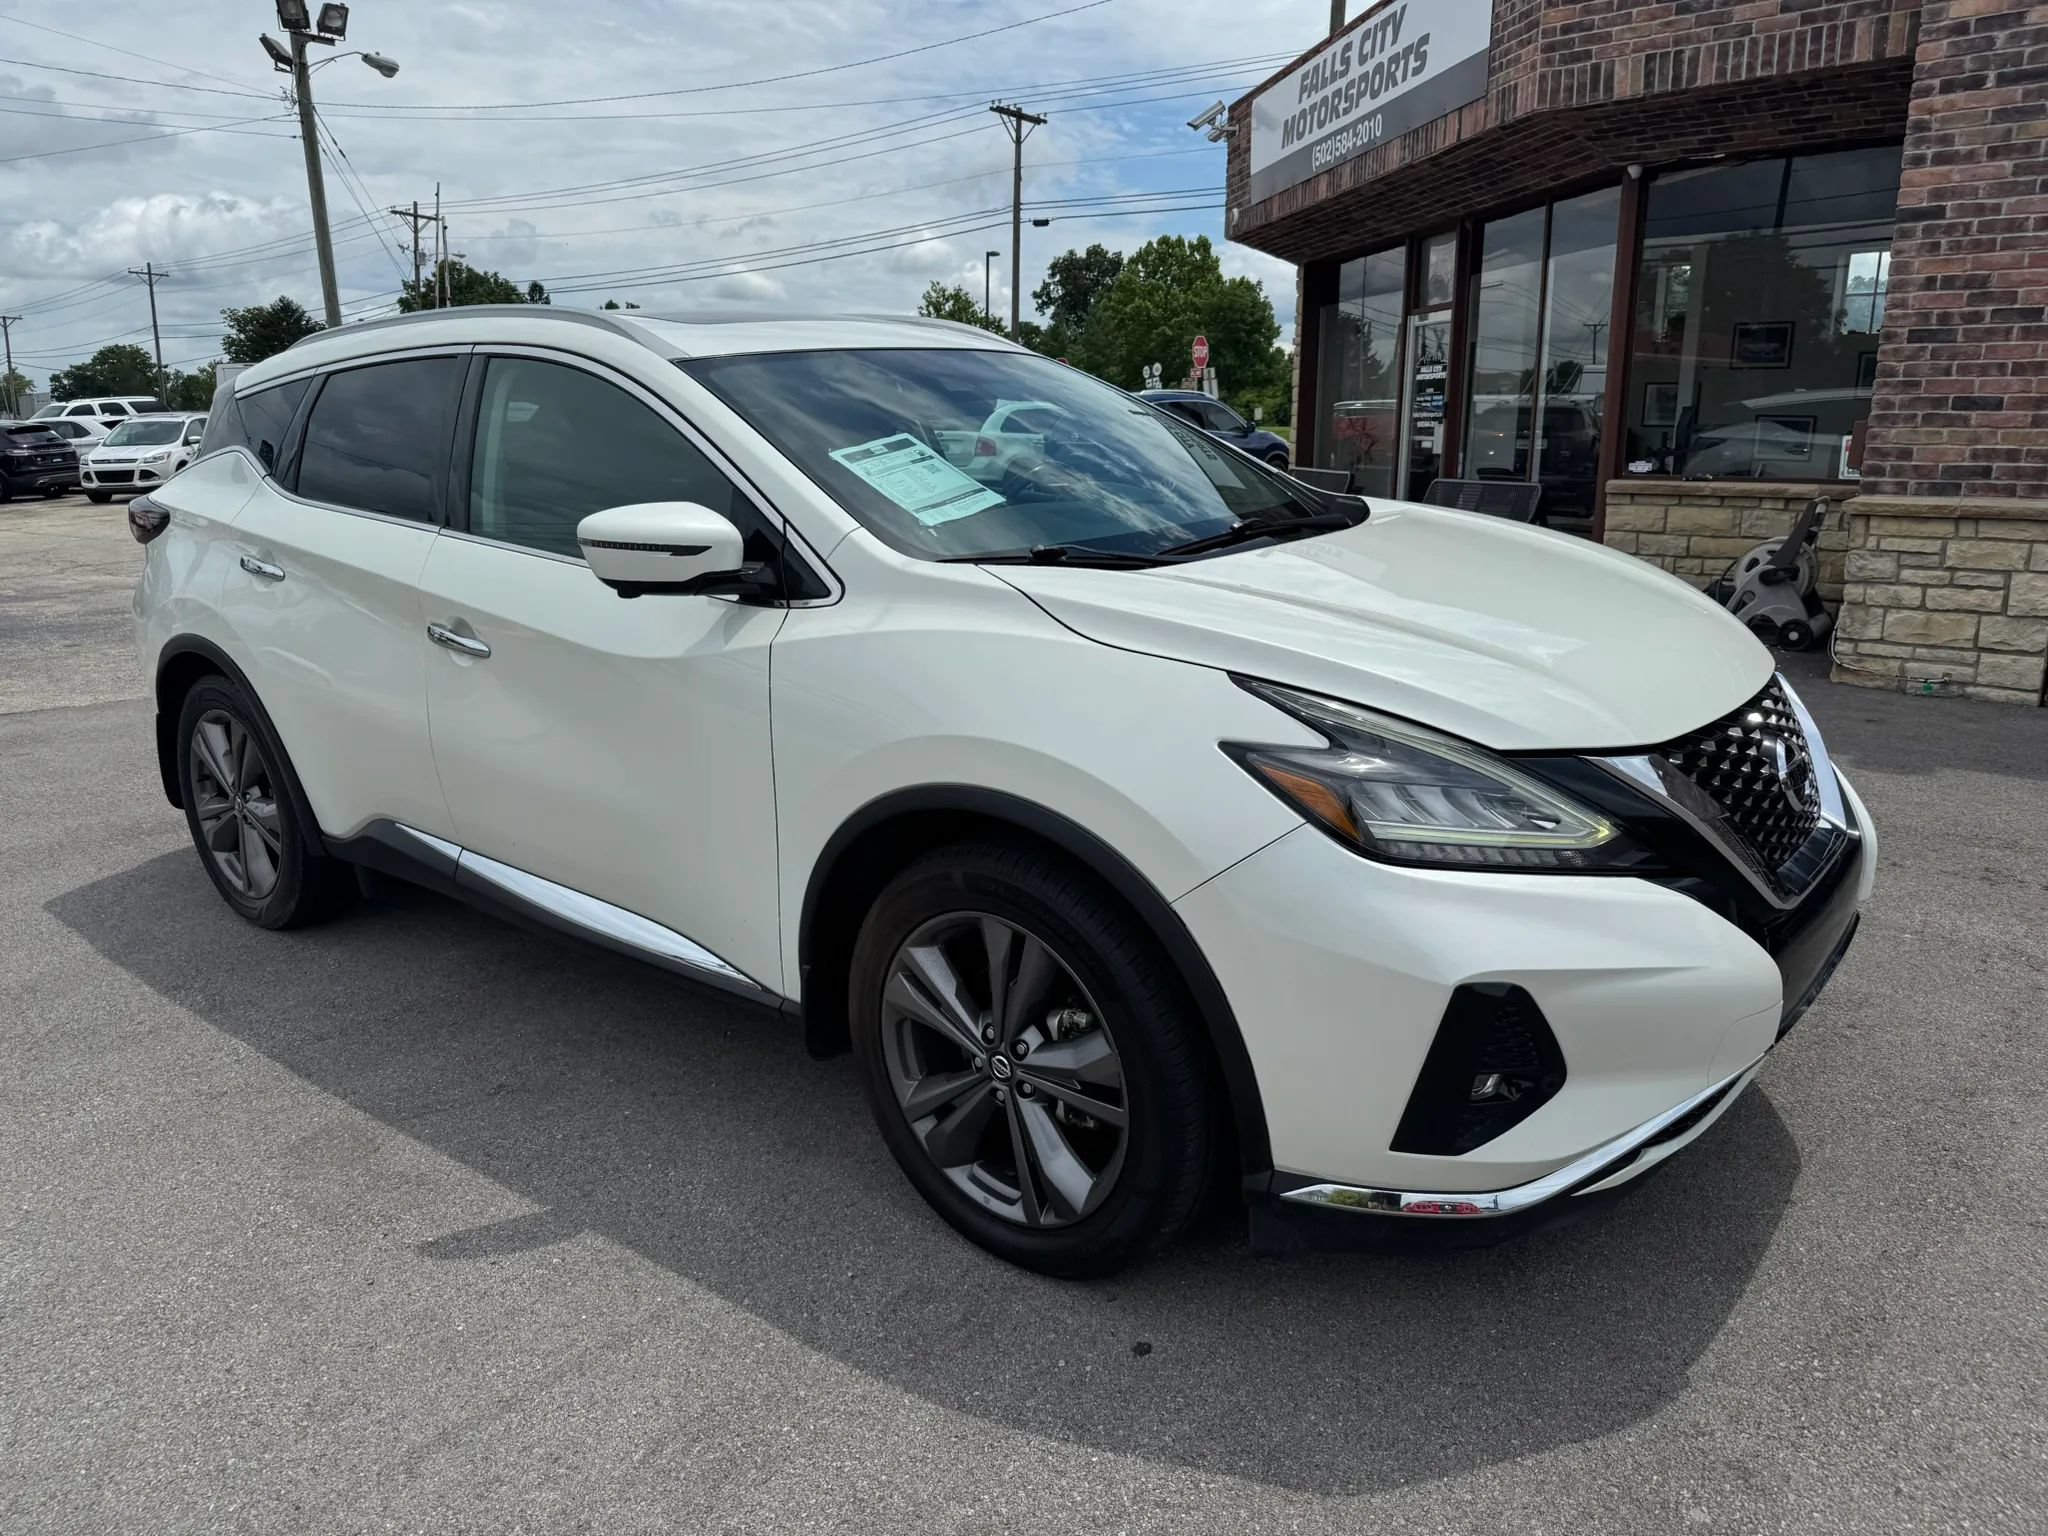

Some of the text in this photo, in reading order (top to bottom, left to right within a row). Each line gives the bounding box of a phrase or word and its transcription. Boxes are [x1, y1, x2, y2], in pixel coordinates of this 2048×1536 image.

[1281, 33, 1430, 148] MOTORSPORTS
[1298, 3, 1407, 104] FALLS CITY
[1312, 113, 1382, 171] (502)584-2010
[1193, 346, 1208, 357] STOP
